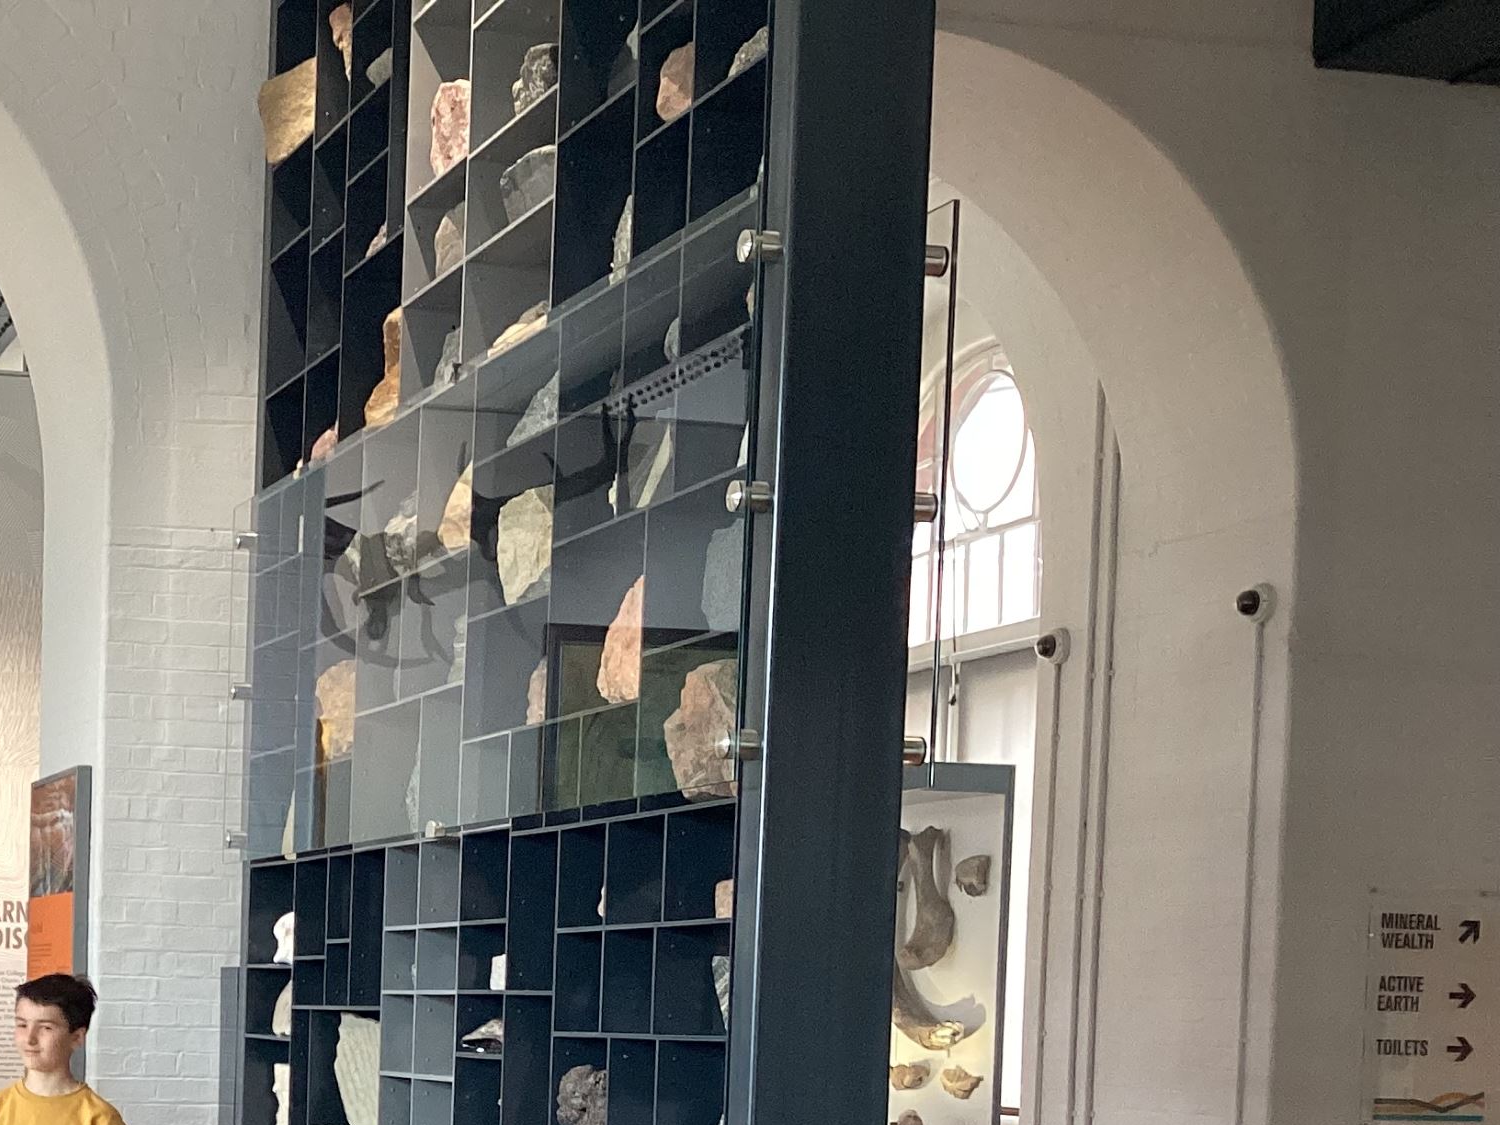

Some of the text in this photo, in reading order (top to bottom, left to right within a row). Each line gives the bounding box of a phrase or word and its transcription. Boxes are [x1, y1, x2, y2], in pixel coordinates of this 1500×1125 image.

[1381, 912, 1441, 931] MINERAL
[1381, 932, 1434, 949] WEALTH
[1379, 975, 1425, 993] ACTIVE
[1377, 995, 1420, 1012] EARTH
[1376, 1039, 1429, 1056] TOILETS
